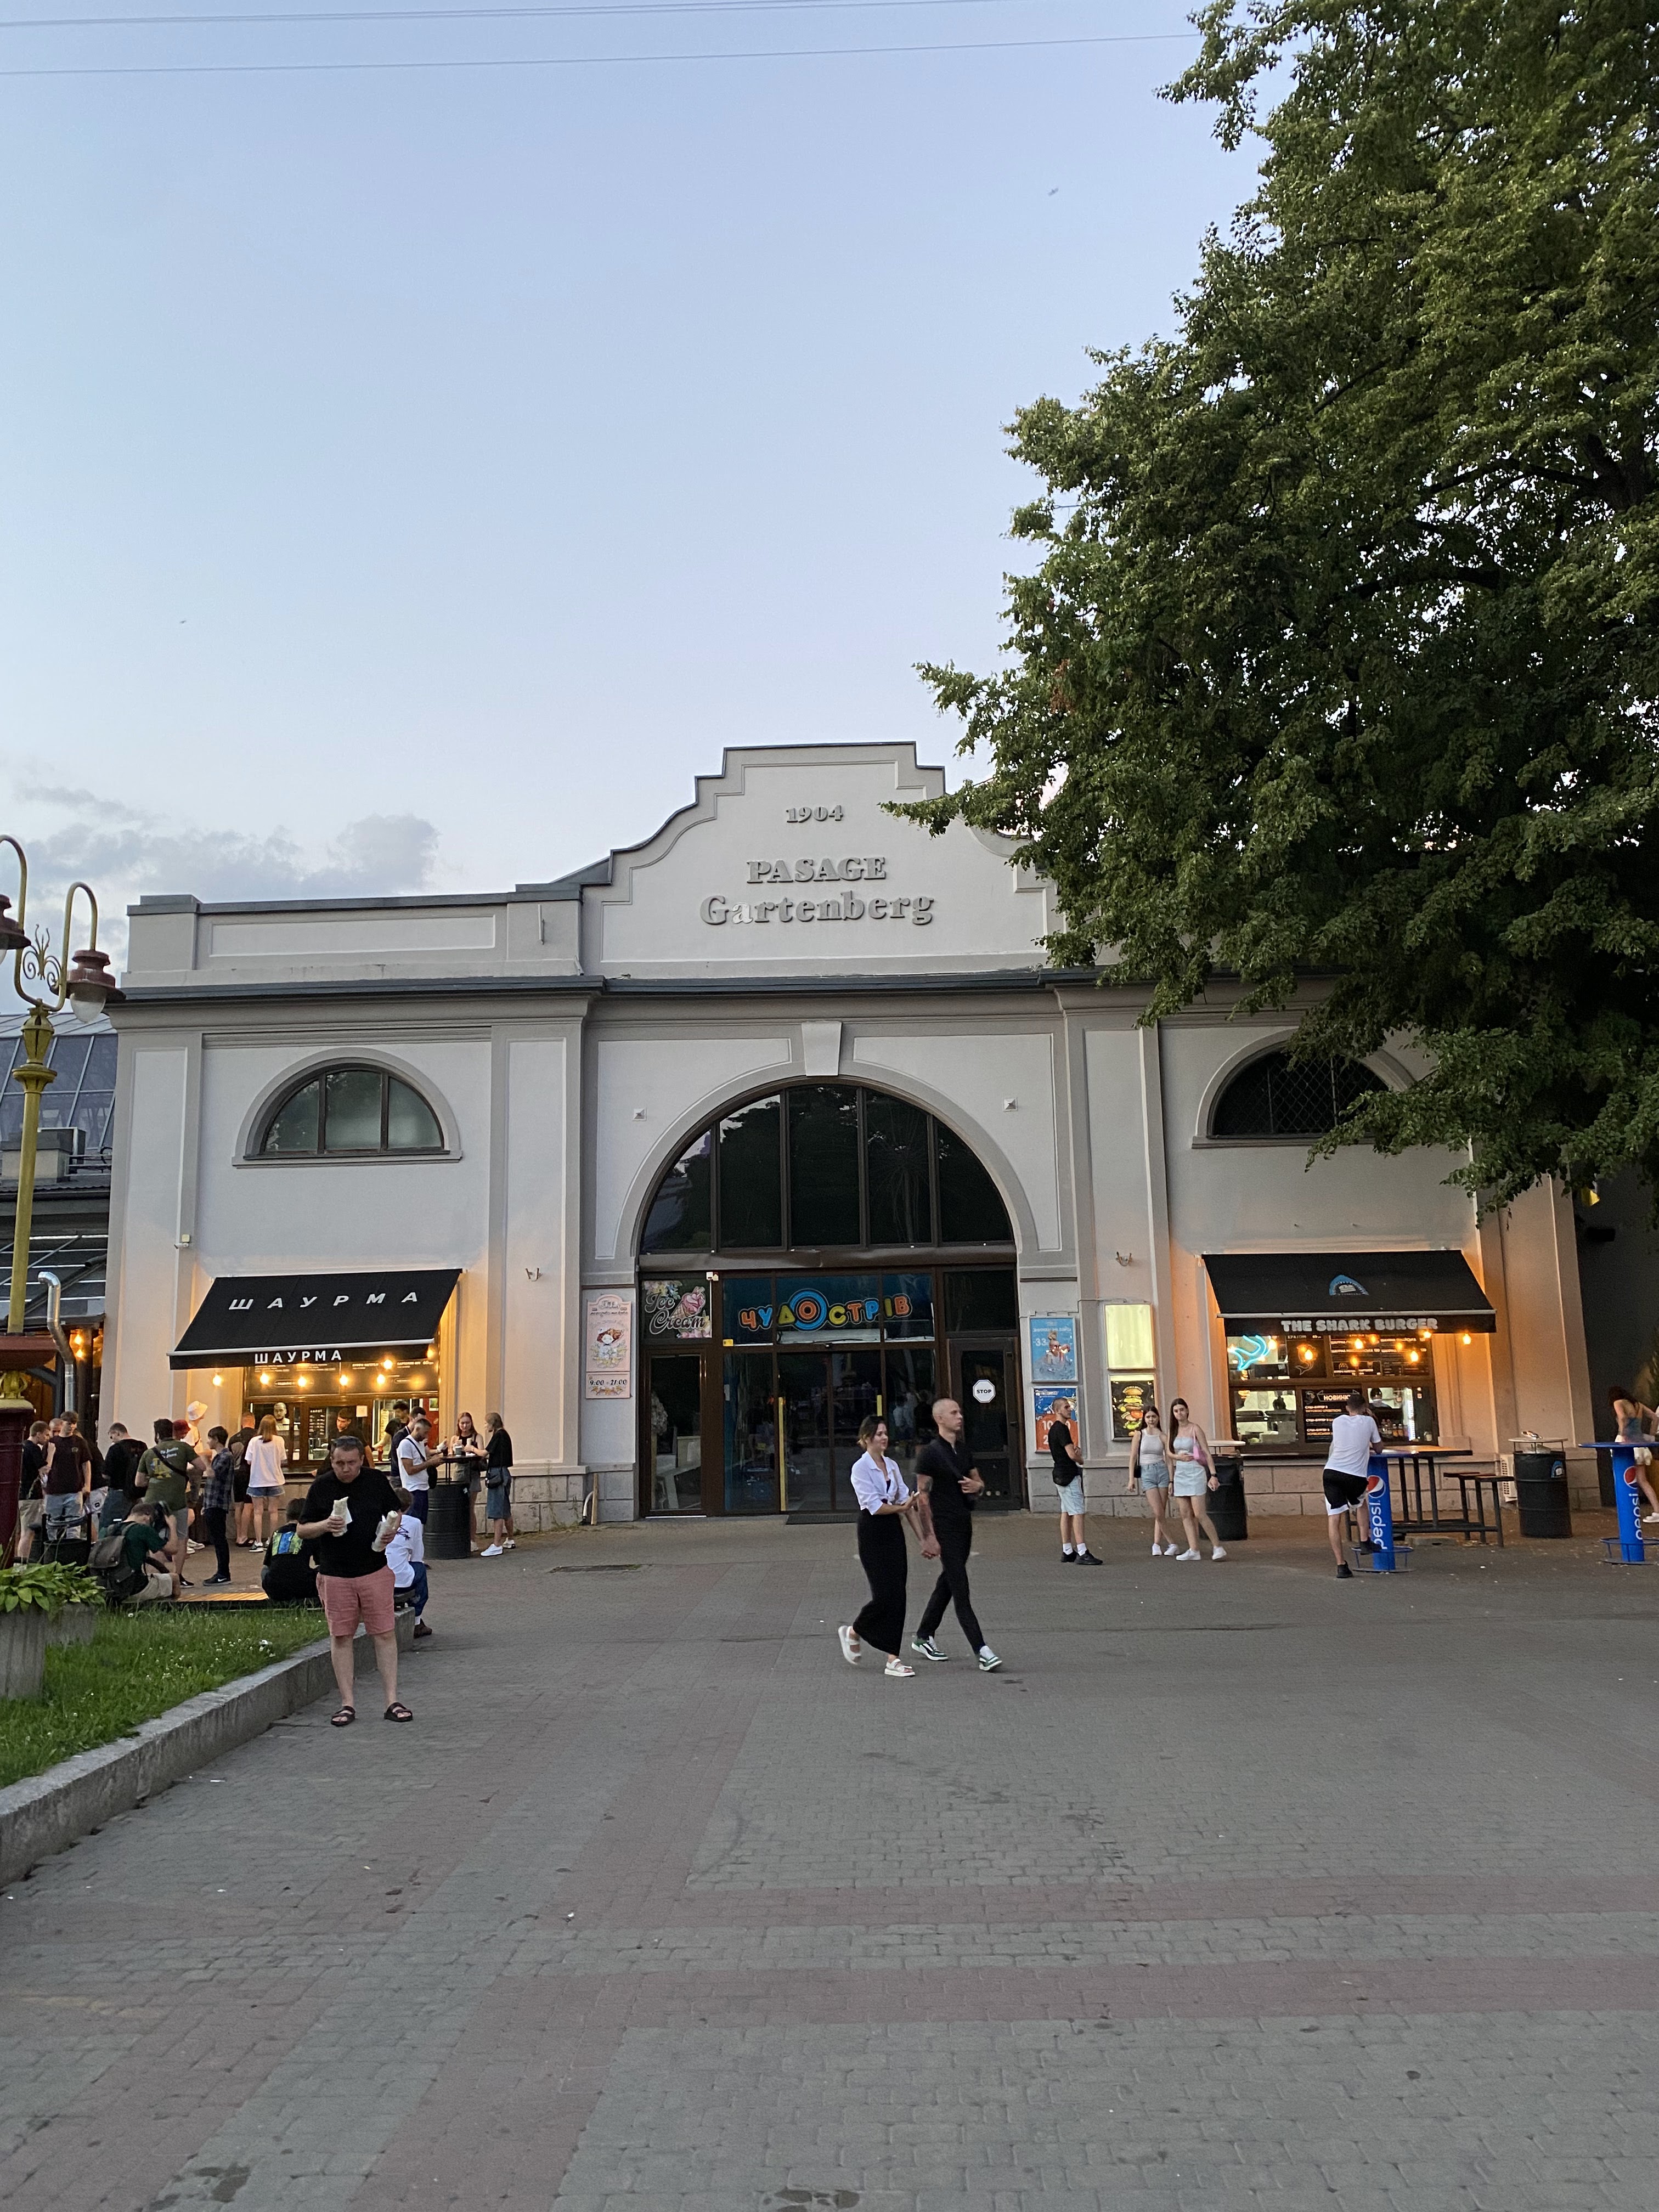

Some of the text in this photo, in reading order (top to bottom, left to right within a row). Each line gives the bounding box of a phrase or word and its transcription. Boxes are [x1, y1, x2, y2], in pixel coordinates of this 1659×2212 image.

[786, 805, 843, 823] 1904
[746, 857, 887, 884] PASAGE
[699, 890, 934, 926] Gartenberg
[229, 1292, 418, 1310] ШАУРМА
[645, 1292, 675, 1313] Ice
[650, 1308, 706, 1335] Cream
[1281, 1318, 1438, 1332] THE SHARK BURGER
[255, 1350, 342, 1364] ШАУРМА
[1369, 1500, 1388, 1550] pepsi
